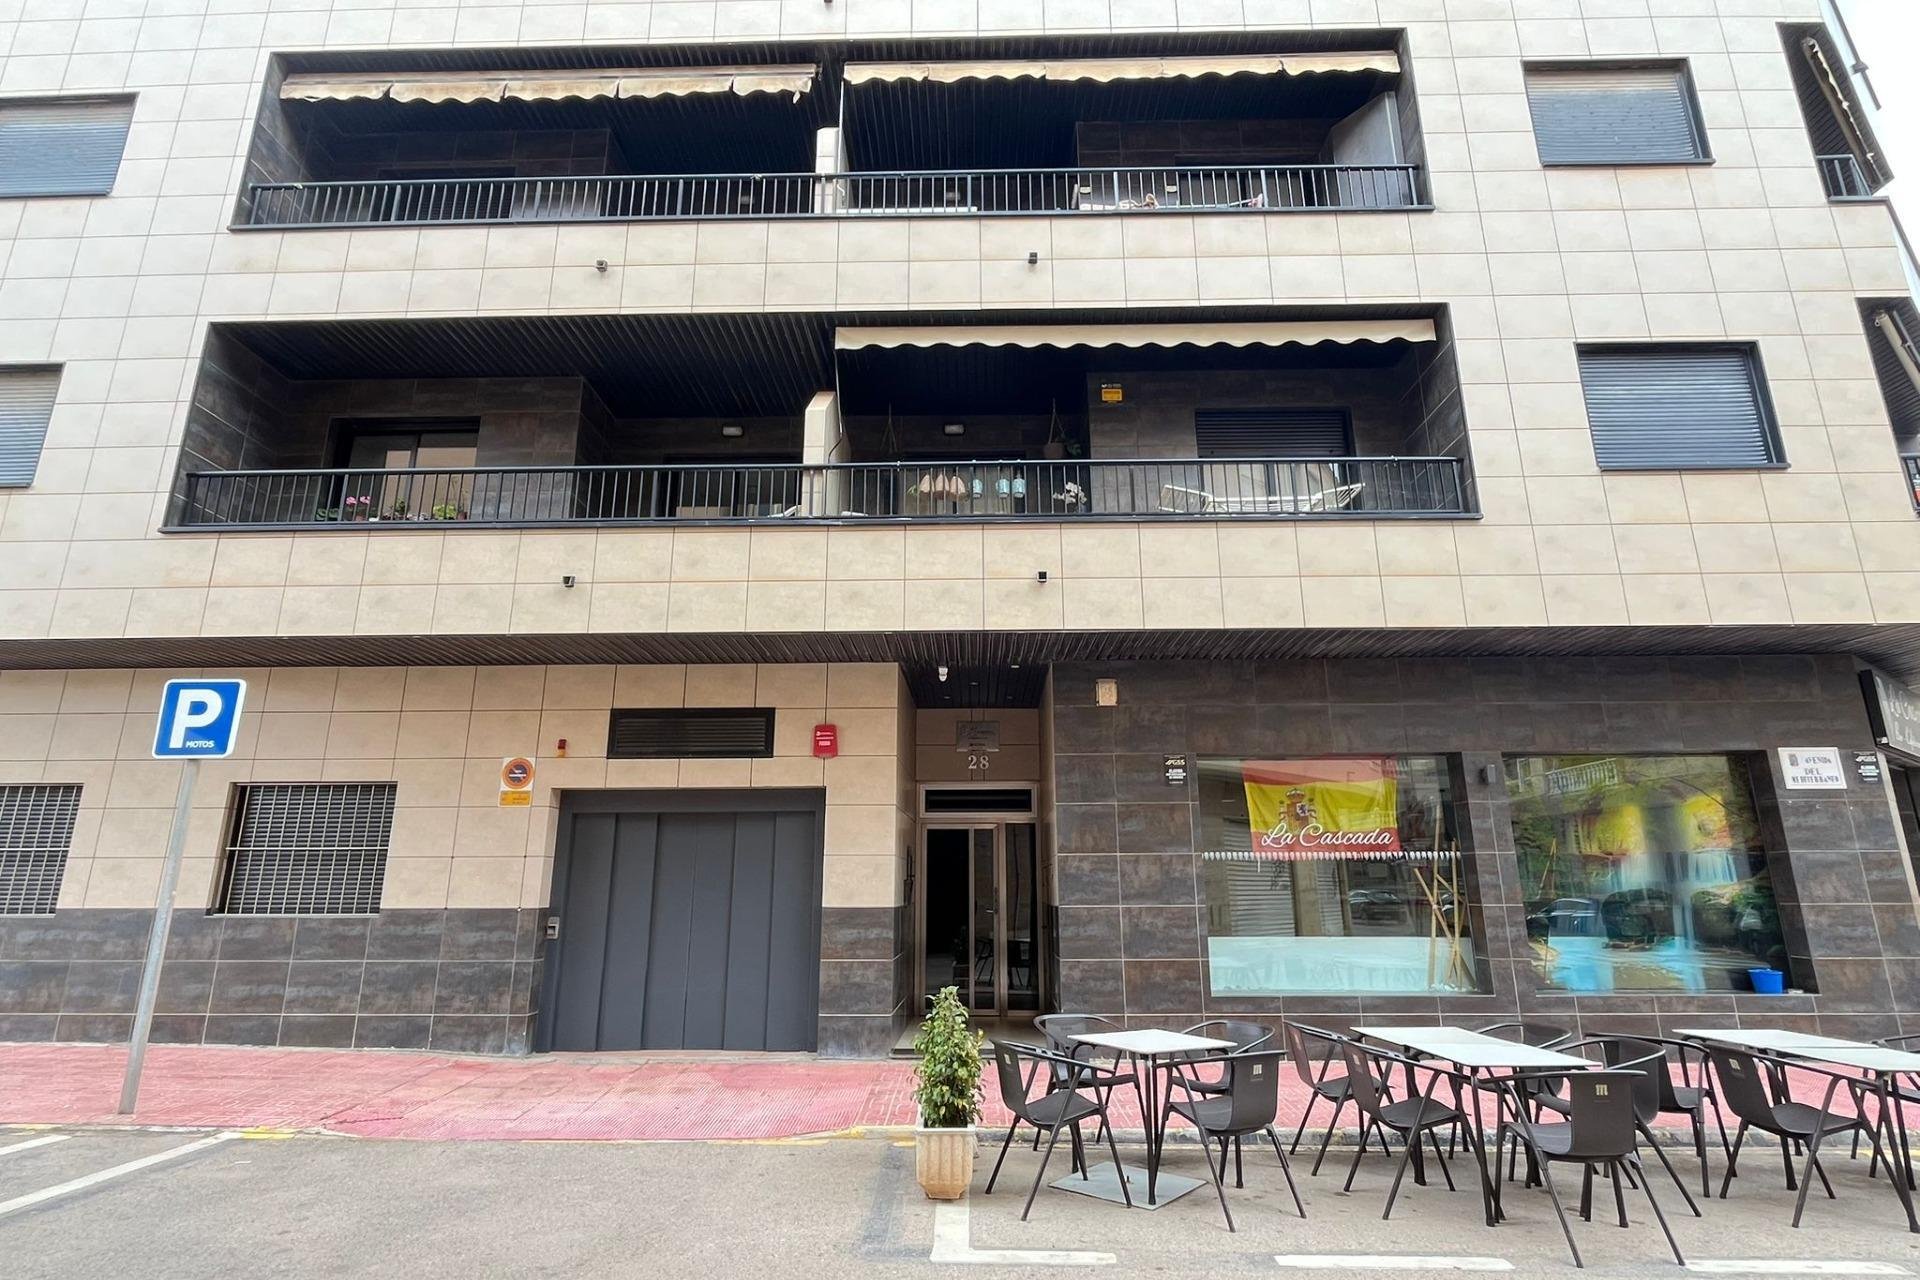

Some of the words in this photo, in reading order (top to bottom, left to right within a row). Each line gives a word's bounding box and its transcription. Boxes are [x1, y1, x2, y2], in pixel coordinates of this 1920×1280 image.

[168, 688, 223, 749] P
[184, 739, 216, 749] MOTOS
[968, 755, 990, 769] 28
[1804, 768, 1822, 776] DEL
[1261, 822, 1297, 848] La
[1299, 823, 1394, 847] Cascada
